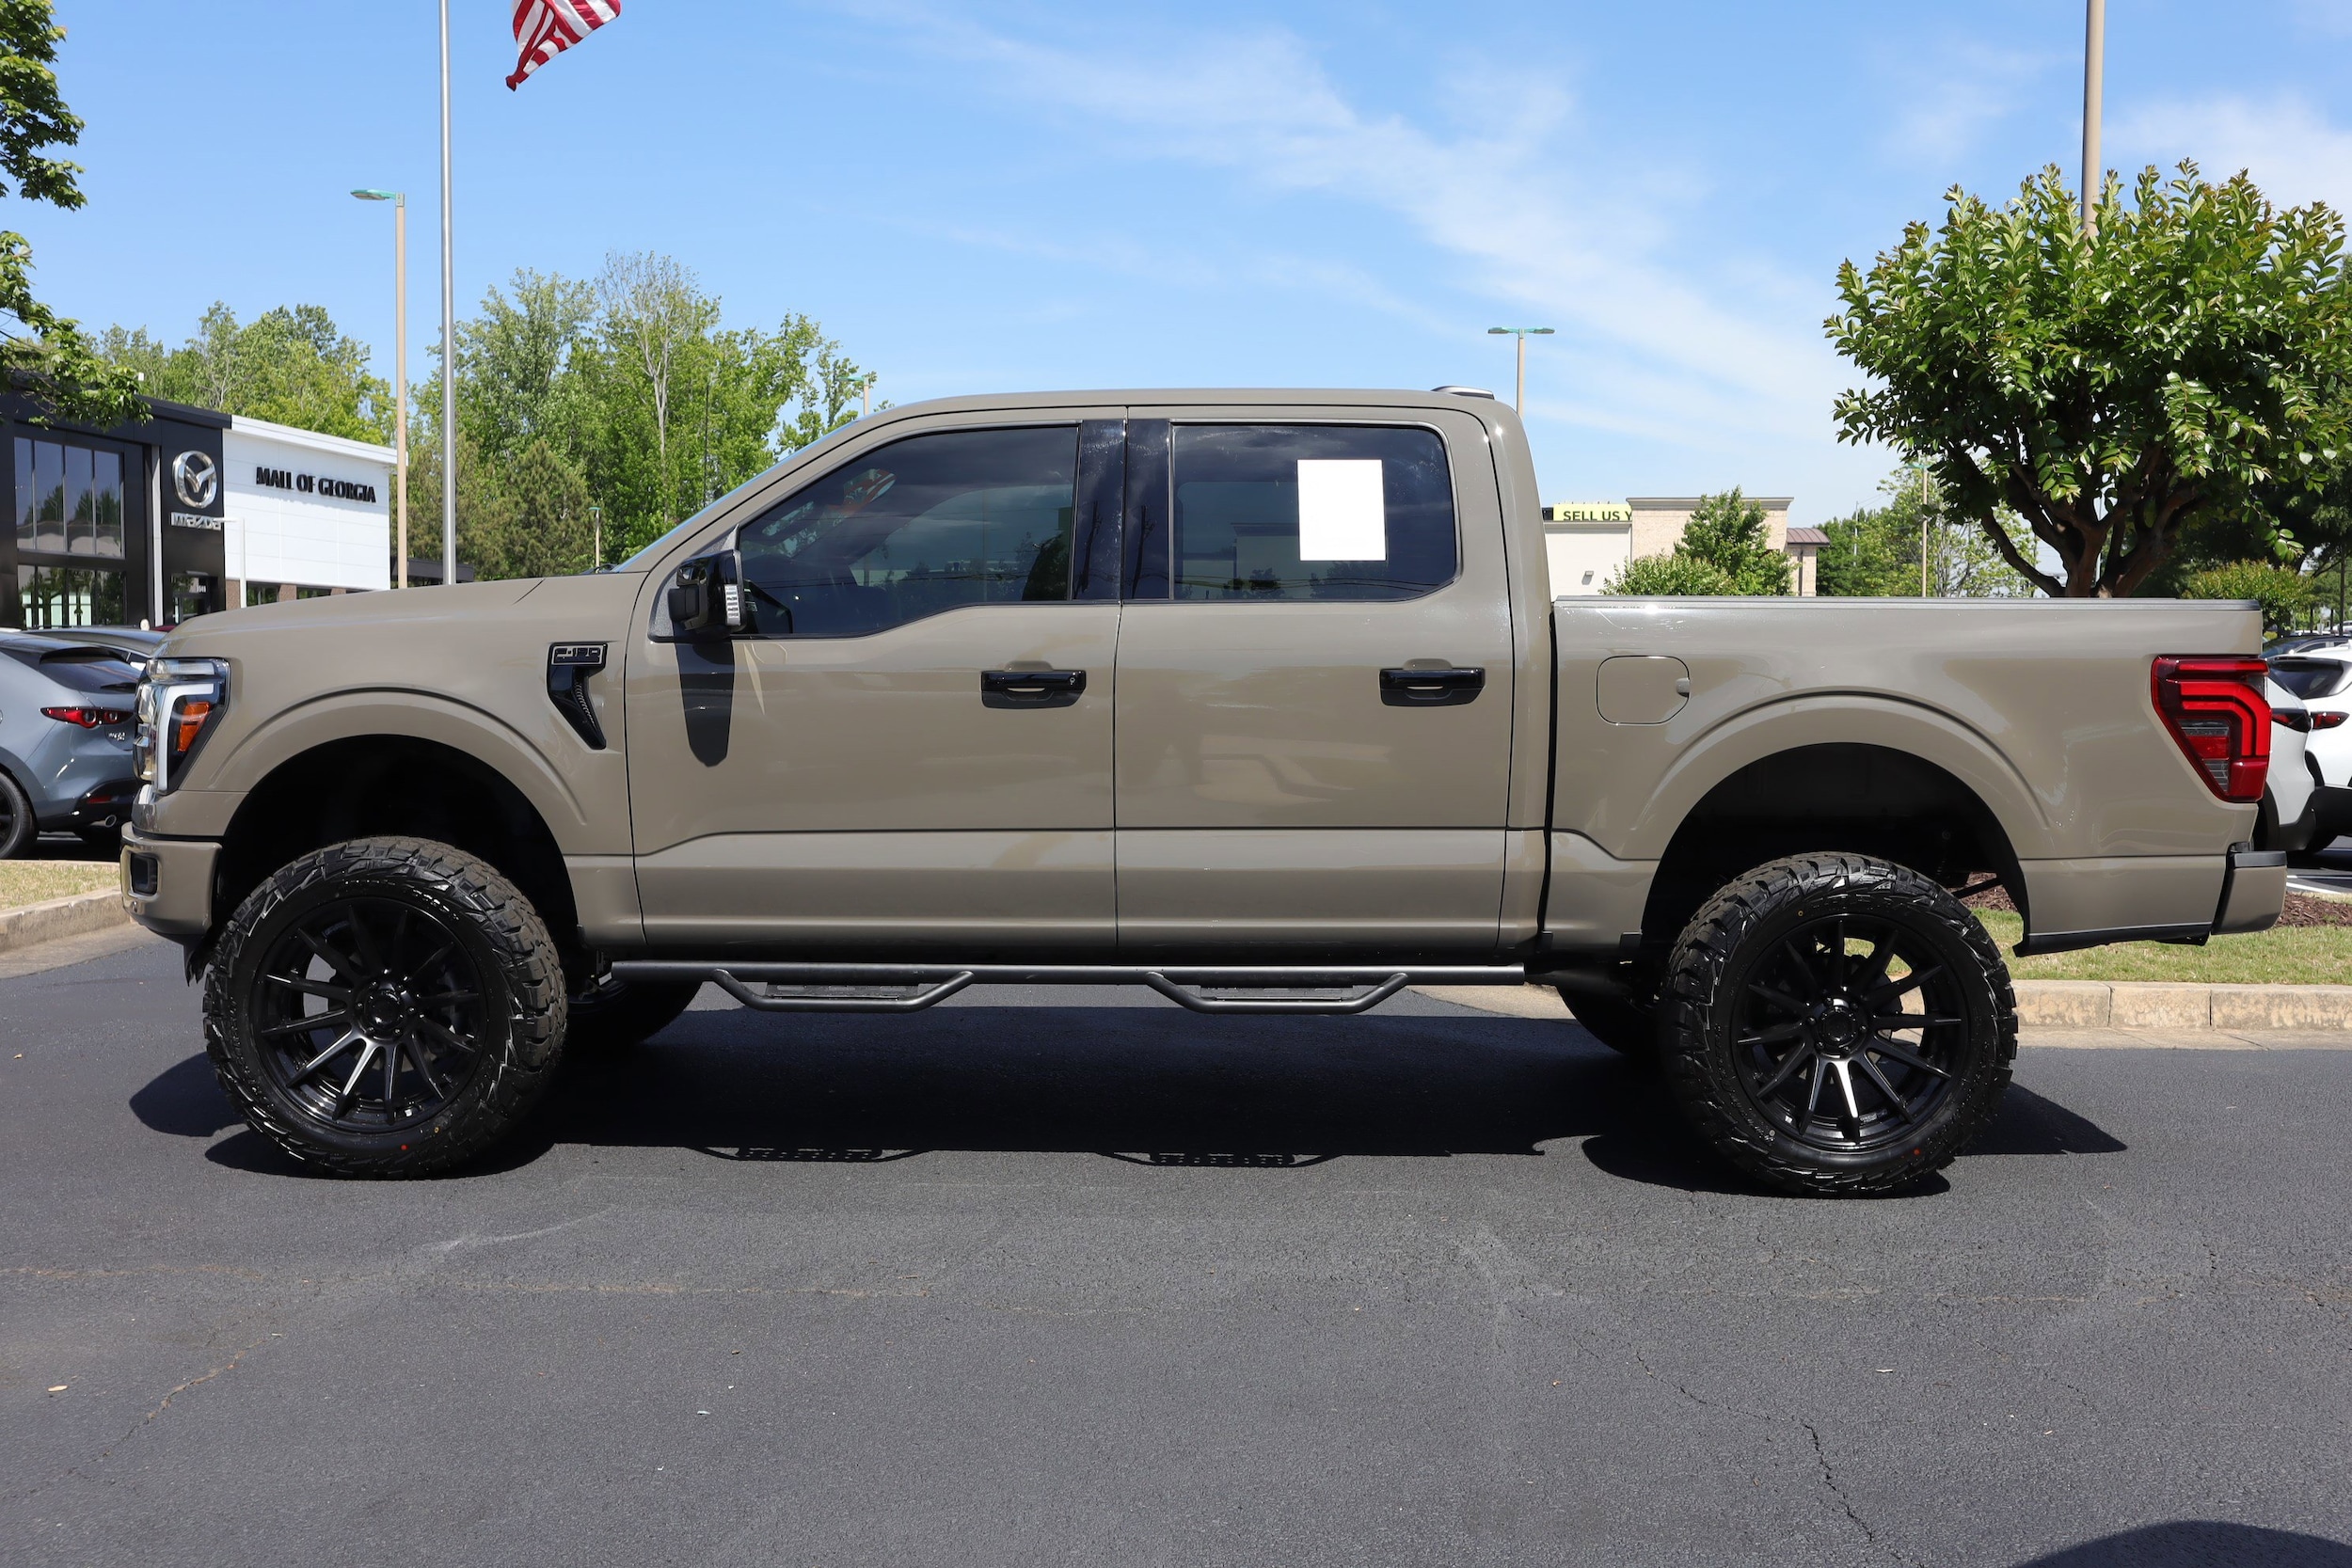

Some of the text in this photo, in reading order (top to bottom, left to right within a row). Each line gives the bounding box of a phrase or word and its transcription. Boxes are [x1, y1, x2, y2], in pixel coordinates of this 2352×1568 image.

[256, 467, 375, 502] MALL OF GEORGIA
[1563, 511, 1597, 520] SELL
[1602, 511, 1620, 520] US
